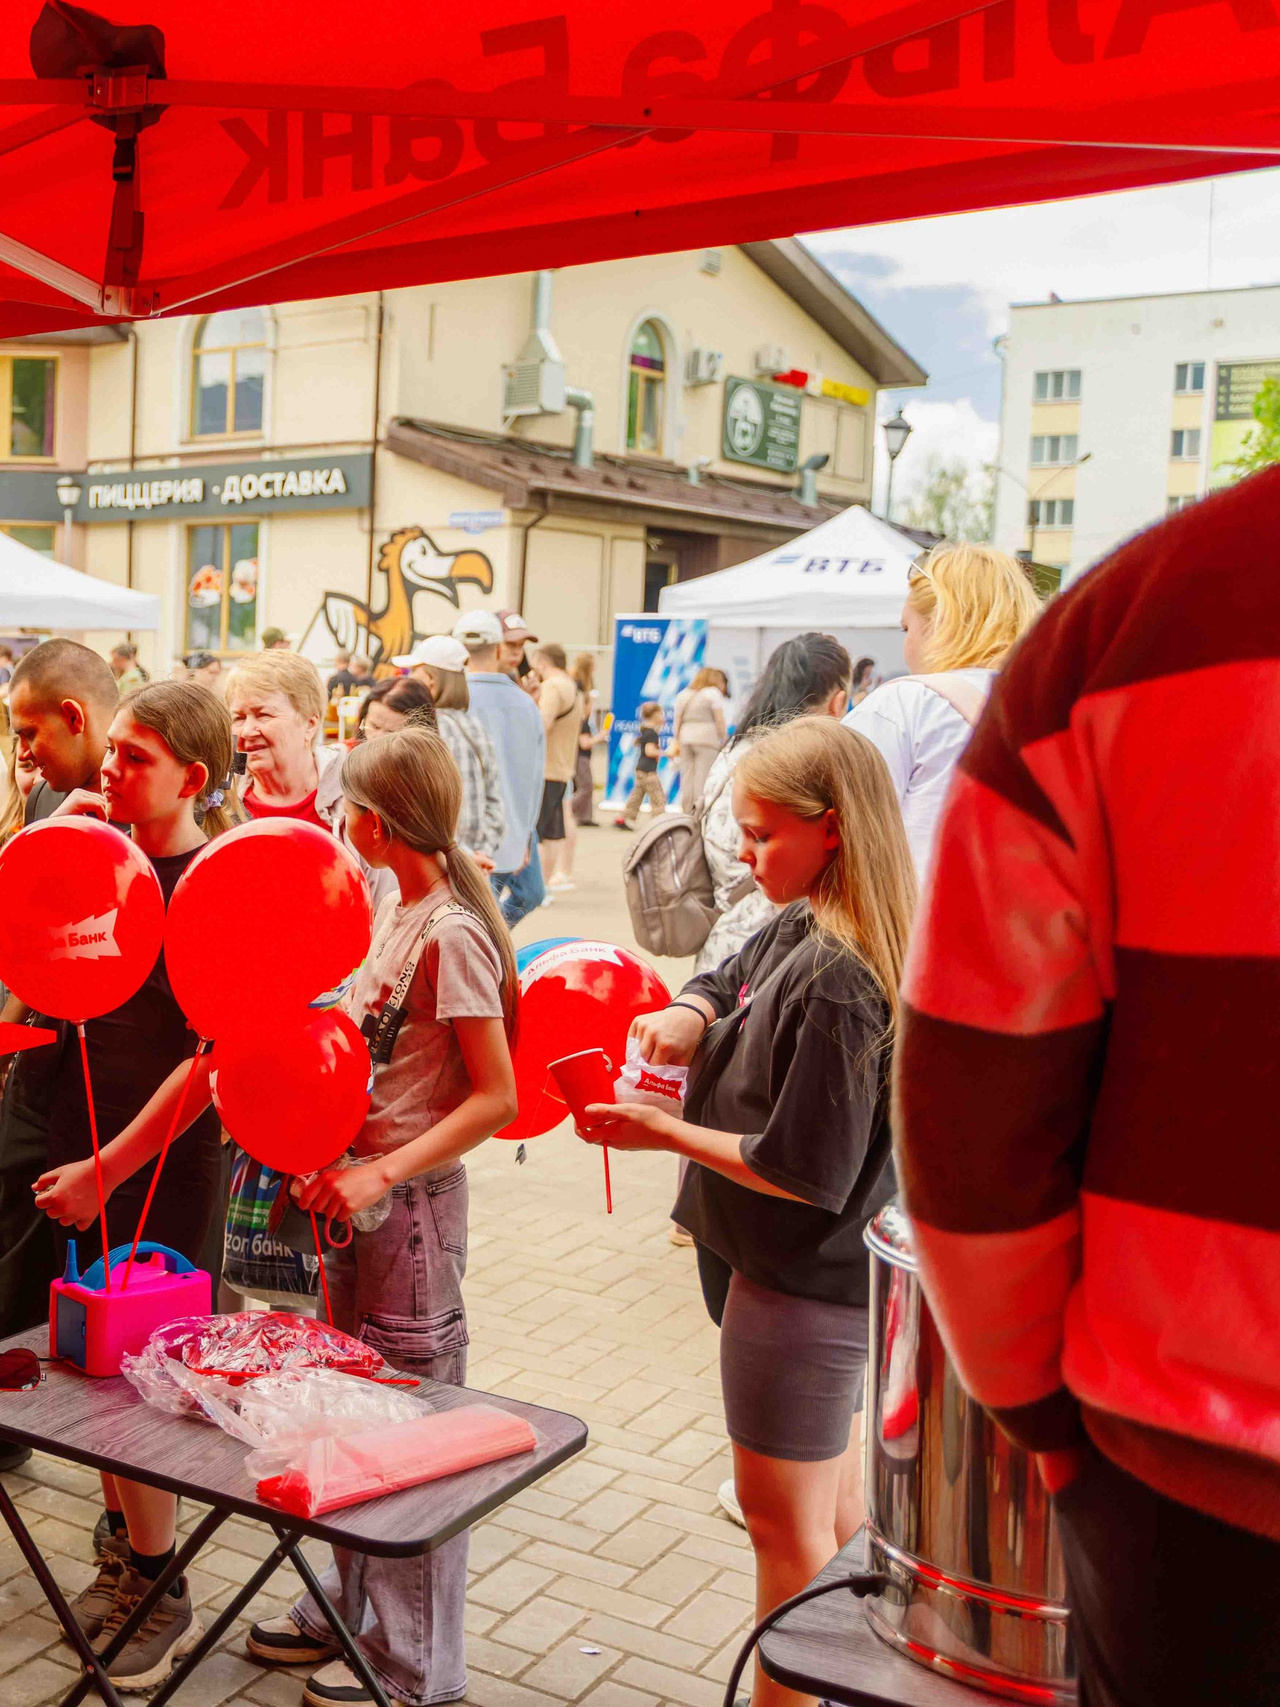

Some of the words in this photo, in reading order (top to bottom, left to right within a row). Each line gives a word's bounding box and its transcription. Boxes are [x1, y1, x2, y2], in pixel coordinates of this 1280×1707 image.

[88, 478, 204, 510] ПИЦЦЕРИЯ
[220, 467, 347, 505] ДОСТАВКА
[804, 557, 887, 574] ВТБ
[67, 931, 108, 948] Банк
[526, 951, 568, 977] Альфа
[569, 946, 608, 954] Банк
[643, 1077, 665, 1090] Альфа
